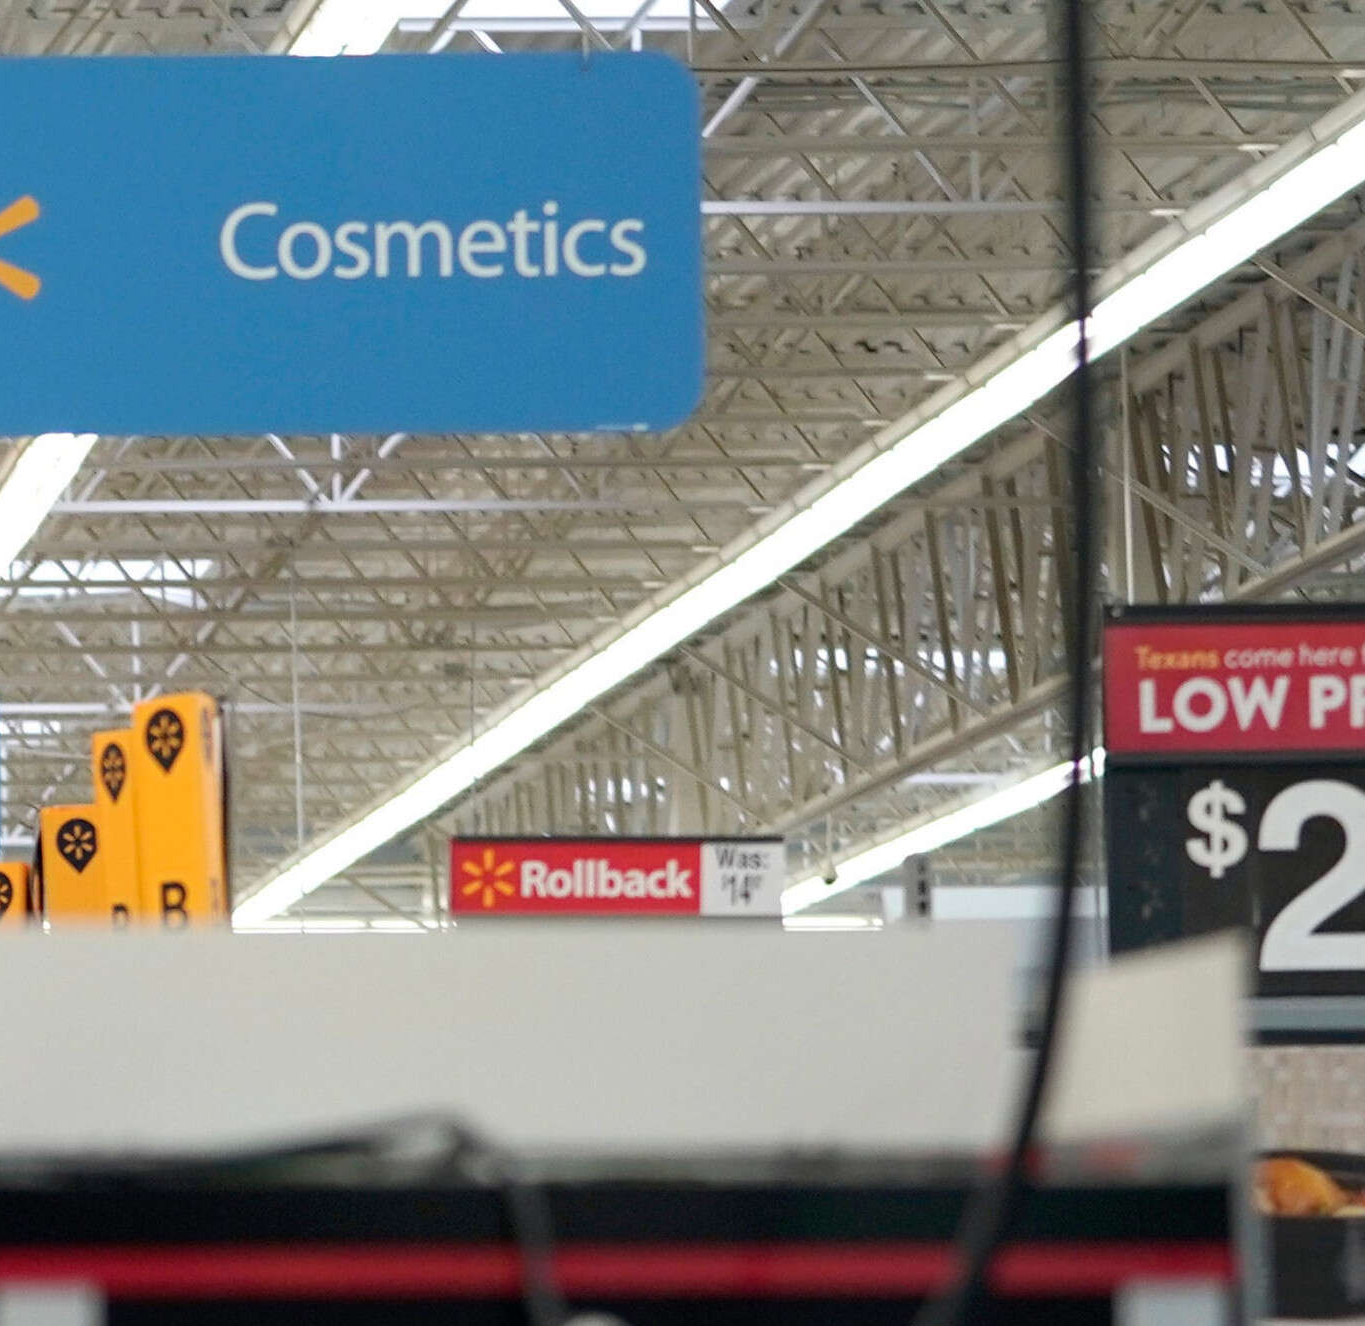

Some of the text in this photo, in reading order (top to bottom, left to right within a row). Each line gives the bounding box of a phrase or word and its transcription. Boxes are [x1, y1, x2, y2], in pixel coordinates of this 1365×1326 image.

[219, 201, 648, 281] Cosmetics
[1223, 649, 1294, 669] come
[1298, 642, 1355, 667] here
[1139, 674, 1291, 734] LOW
[520, 859, 692, 900] Rollback
